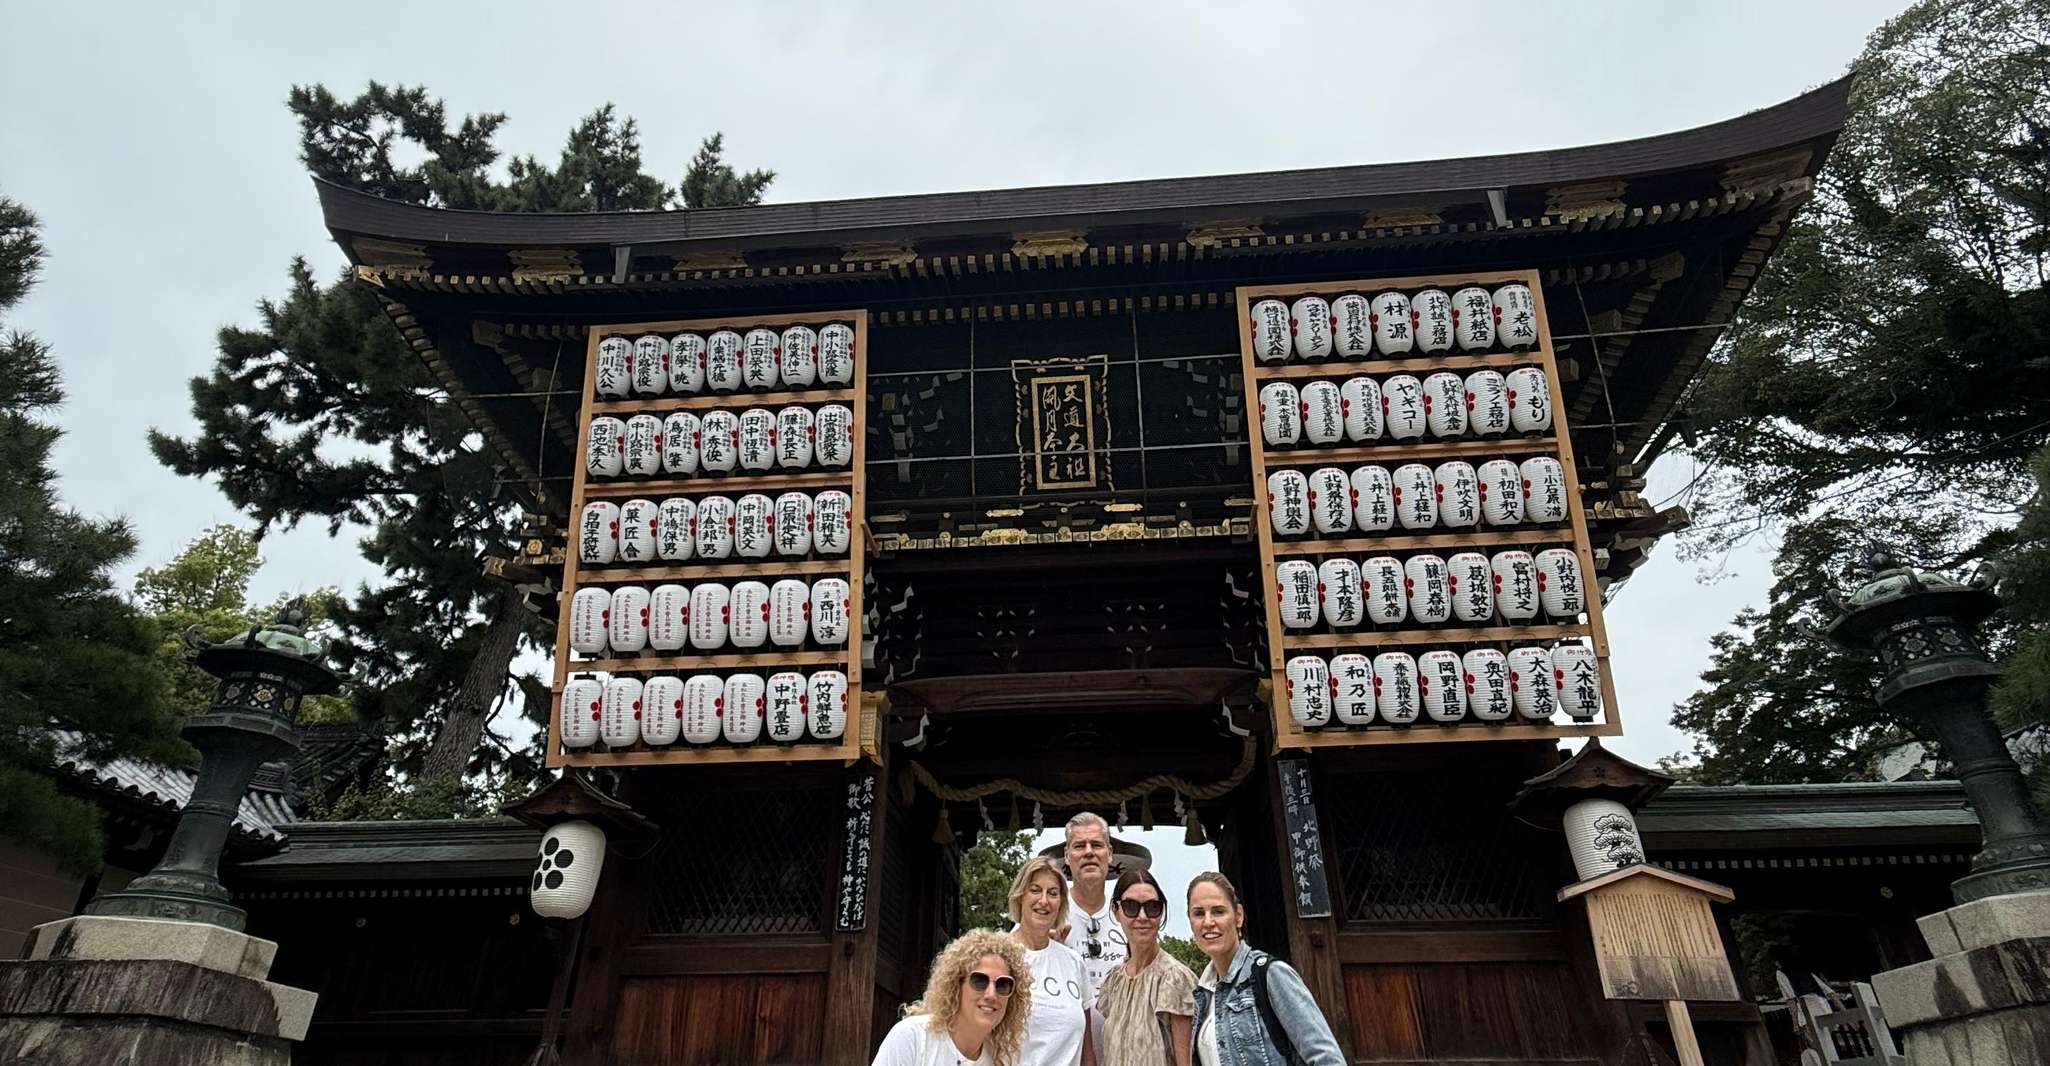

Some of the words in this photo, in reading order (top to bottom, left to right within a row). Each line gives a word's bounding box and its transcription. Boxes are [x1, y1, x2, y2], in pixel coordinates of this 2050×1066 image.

[1384, 300, 1408, 339] 材源
[1465, 295, 1489, 342] 福井紙店
[1512, 311, 1533, 338] 老松
[1396, 383, 1417, 430] ヤギコー
[1527, 397, 1545, 423] もり
[1453, 478, 1473, 521] 伊吹文明
[814, 681, 834, 735] 竹内鮮魚店
[1345, 665, 1368, 717] 和乃匠
[1437, 661, 1461, 716] 岡野直臣
[1529, 656, 1551, 714] 大森英治
[1571, 659, 1598, 714] 八木龍平
